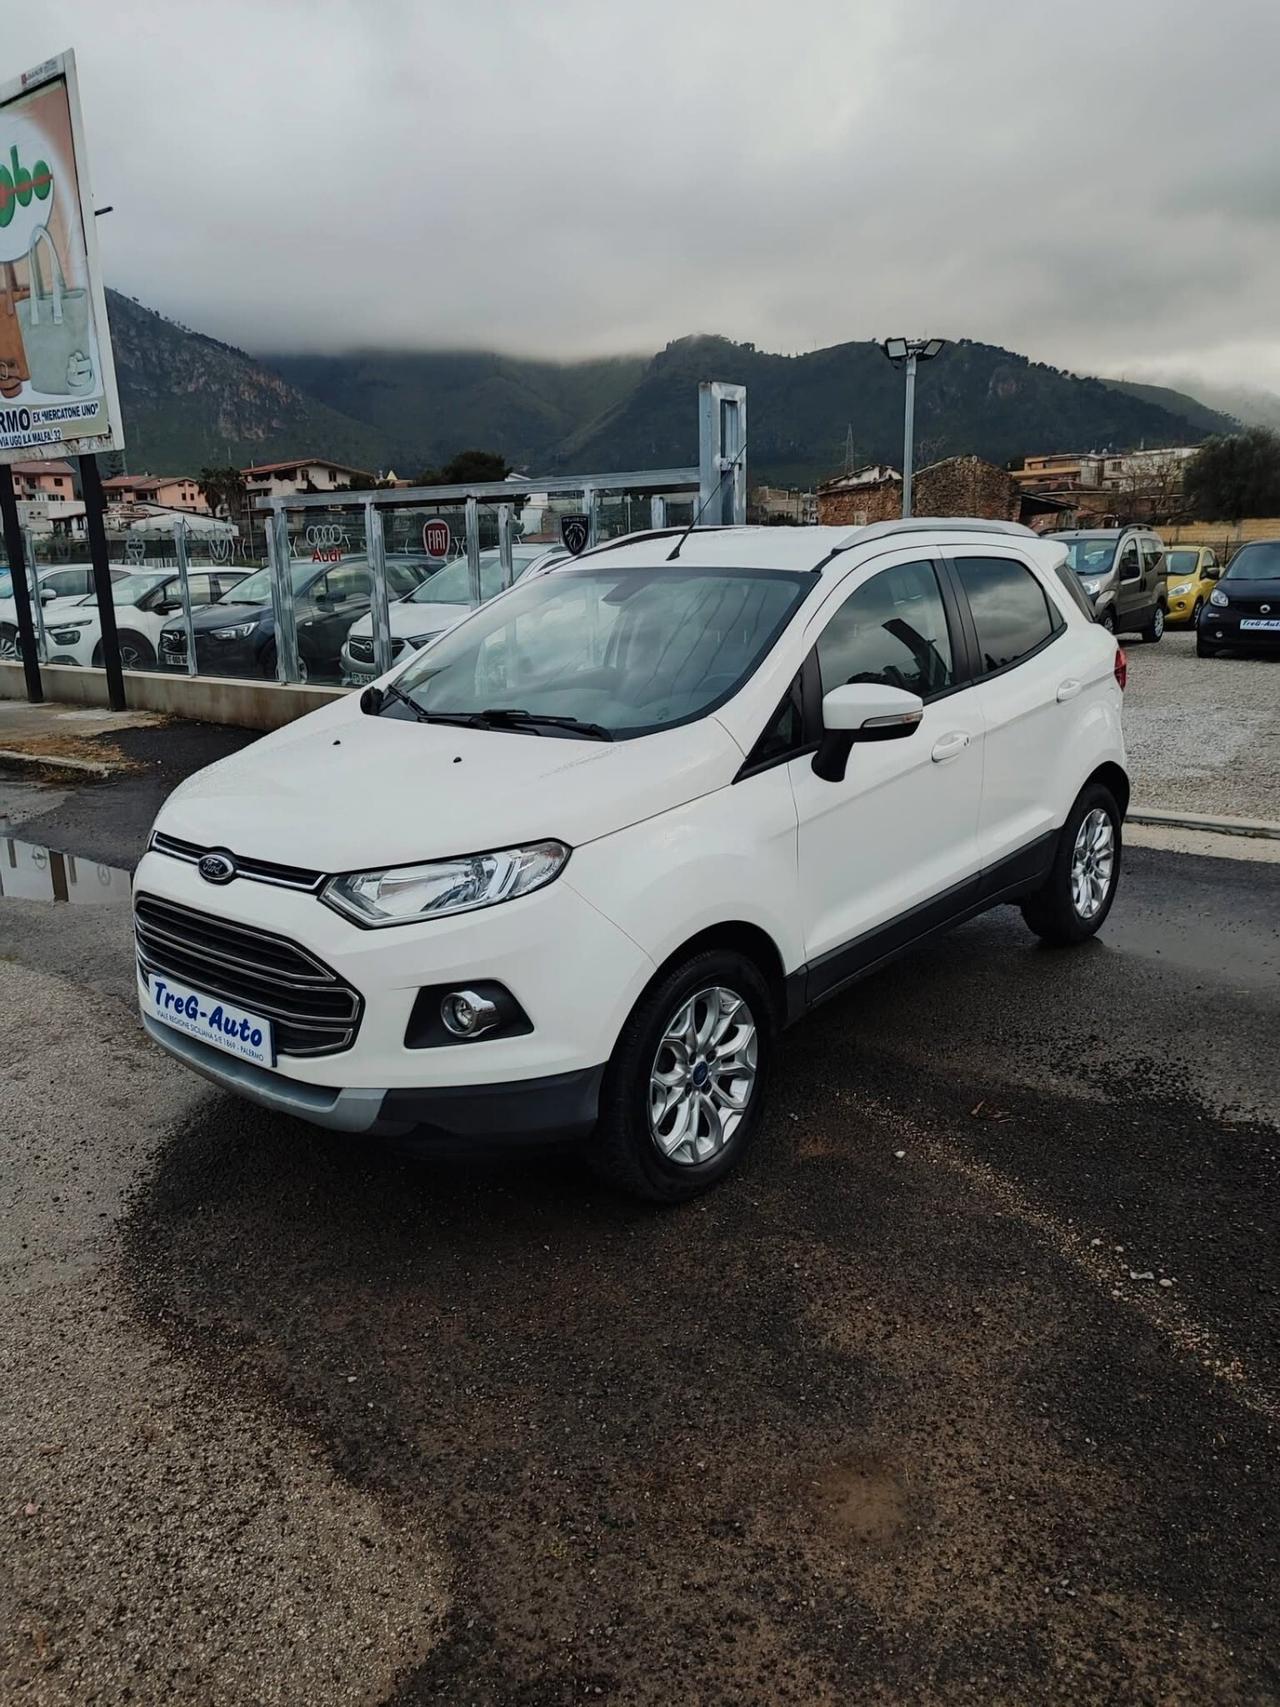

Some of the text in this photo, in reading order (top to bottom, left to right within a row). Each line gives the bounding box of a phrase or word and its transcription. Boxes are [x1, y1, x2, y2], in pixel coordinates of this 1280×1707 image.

[33, 412, 41, 423] EX
[10, 435, 22, 446] UGO
[23, 434, 31, 445] LA
[427, 529, 446, 550] FIAT
[312, 543, 342, 562] Audi
[202, 858, 223, 874] Ford
[154, 982, 263, 1047] TreG-Auto
